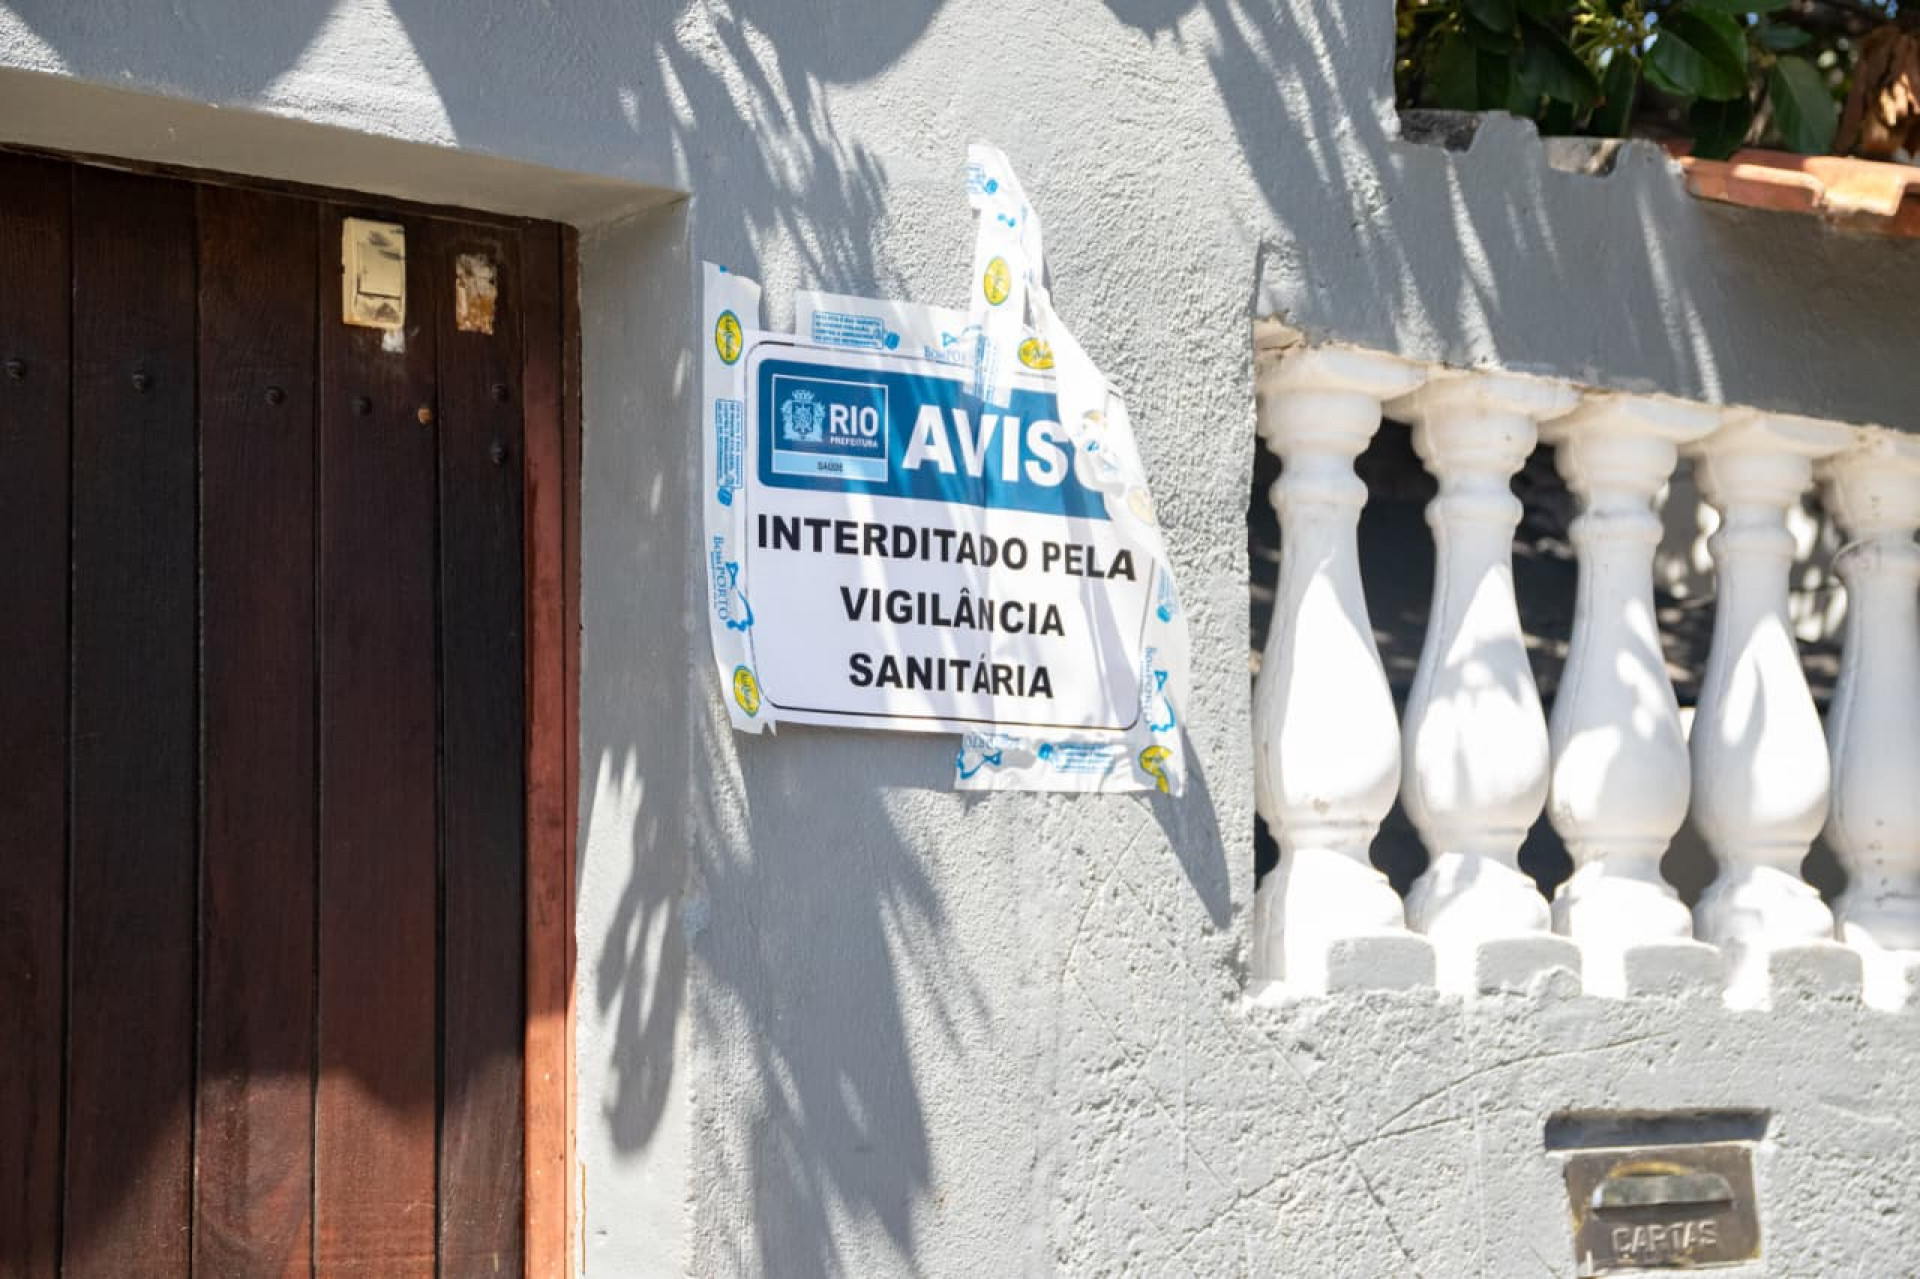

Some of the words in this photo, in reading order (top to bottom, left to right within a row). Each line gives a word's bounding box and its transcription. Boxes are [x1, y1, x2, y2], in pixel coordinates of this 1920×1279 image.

[829, 403, 880, 438] RIO
[758, 513, 1028, 570] INTERDITADO
[1043, 541, 1136, 581] PELA
[839, 586, 1066, 637] VIGILÂNCIA
[848, 648, 1054, 699] SANITÁRIA
[1611, 1219, 1718, 1253] CARTAS
